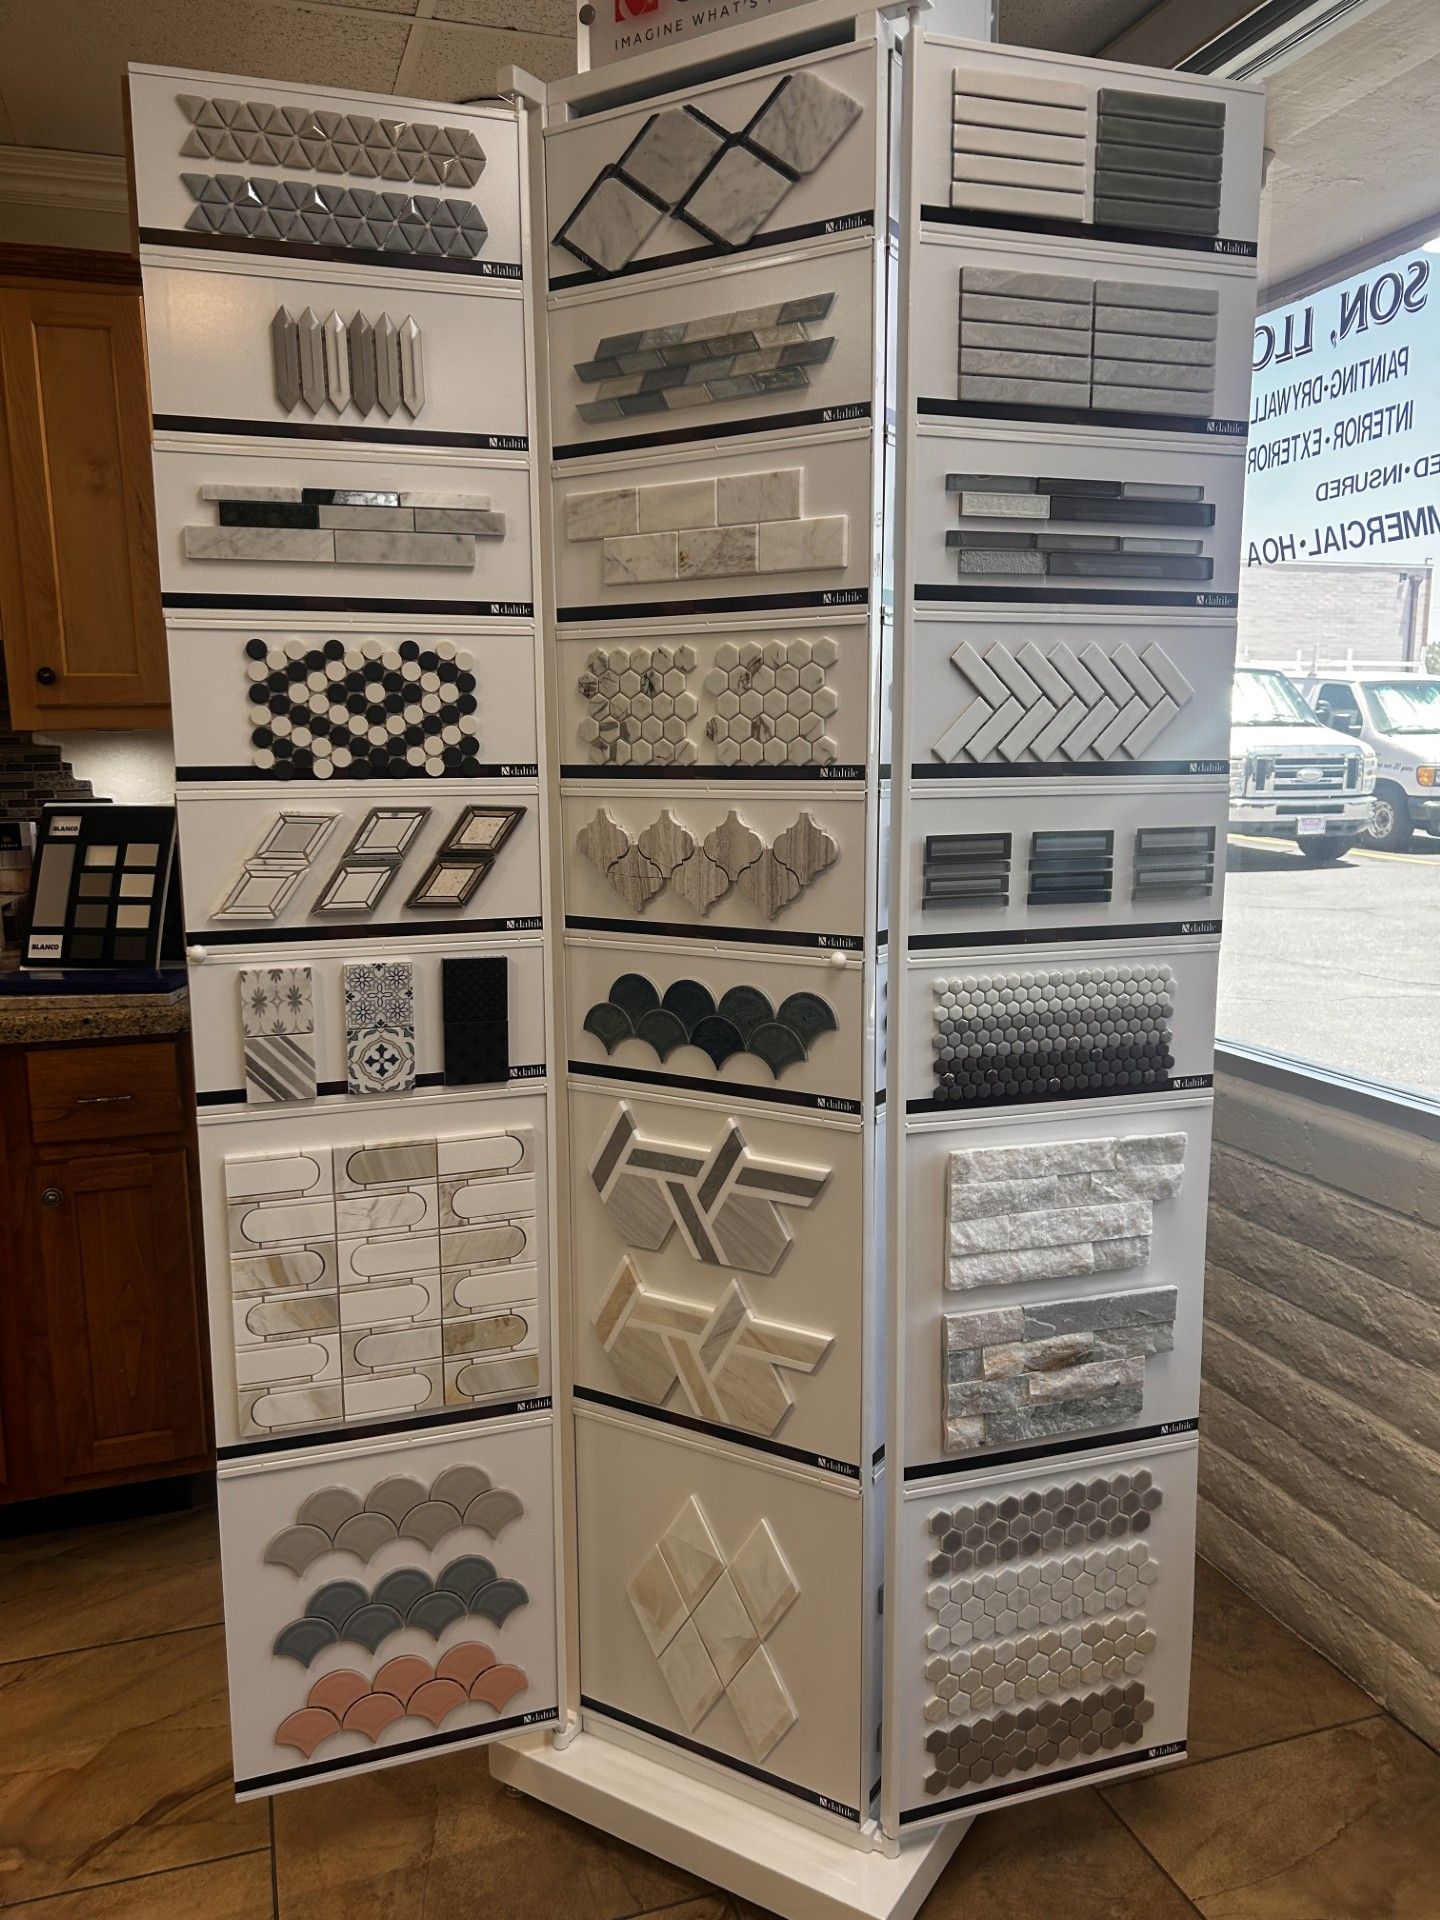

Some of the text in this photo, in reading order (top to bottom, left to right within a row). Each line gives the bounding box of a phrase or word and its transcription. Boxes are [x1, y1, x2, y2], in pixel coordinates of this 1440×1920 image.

[614, 0, 758, 50] IMAGINE WHAT'S
[31, 943, 59, 951] BLANCO
